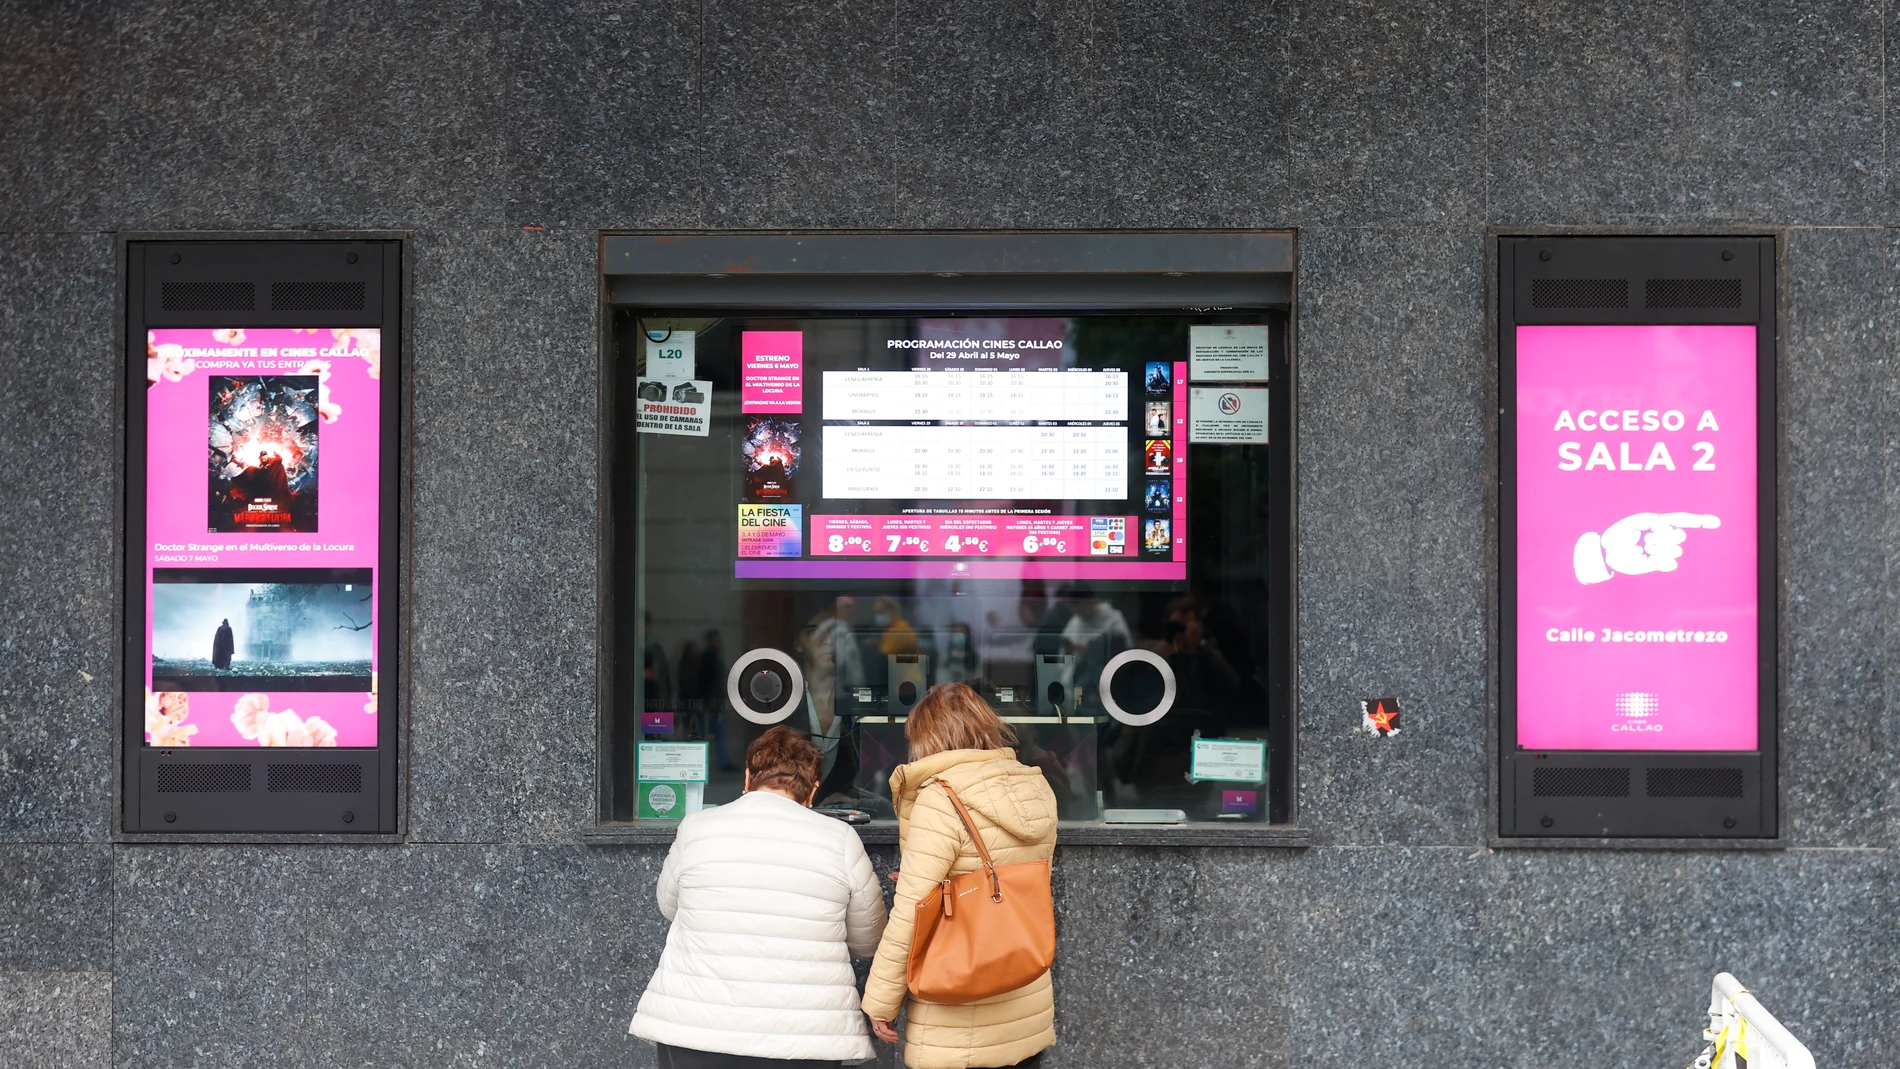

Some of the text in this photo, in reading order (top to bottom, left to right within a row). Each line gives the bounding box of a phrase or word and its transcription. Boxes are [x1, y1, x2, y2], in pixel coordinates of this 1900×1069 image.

[887, 338, 1063, 349] PROGRAMACIÓN CINES CALLAO
[261, 348, 277, 358] EN
[280, 348, 317, 358] CINES
[319, 348, 370, 358] CALLAO
[659, 350, 682, 358] L20
[997, 352, 1020, 360] Mayo
[196, 360, 240, 369] COMPRA
[242, 360, 255, 369] YA
[257, 360, 276, 369] TUS
[644, 404, 696, 415] PROHIBIDO
[670, 416, 703, 424] CAMARAS
[1554, 410, 1719, 431] ACCESO A
[1558, 442, 1716, 471] SALA 2
[188, 544, 224, 553] Strange
[828, 535, 871, 552] 8,00€
[886, 535, 929, 552] 7,50€
[945, 535, 988, 552] 4,50€
[1023, 536, 1066, 553] 6,50€
[154, 554, 187, 562] SÁBADO
[1546, 628, 1728, 642] Calle Jacometrezo
[1611, 724, 1663, 732] CALLAO
